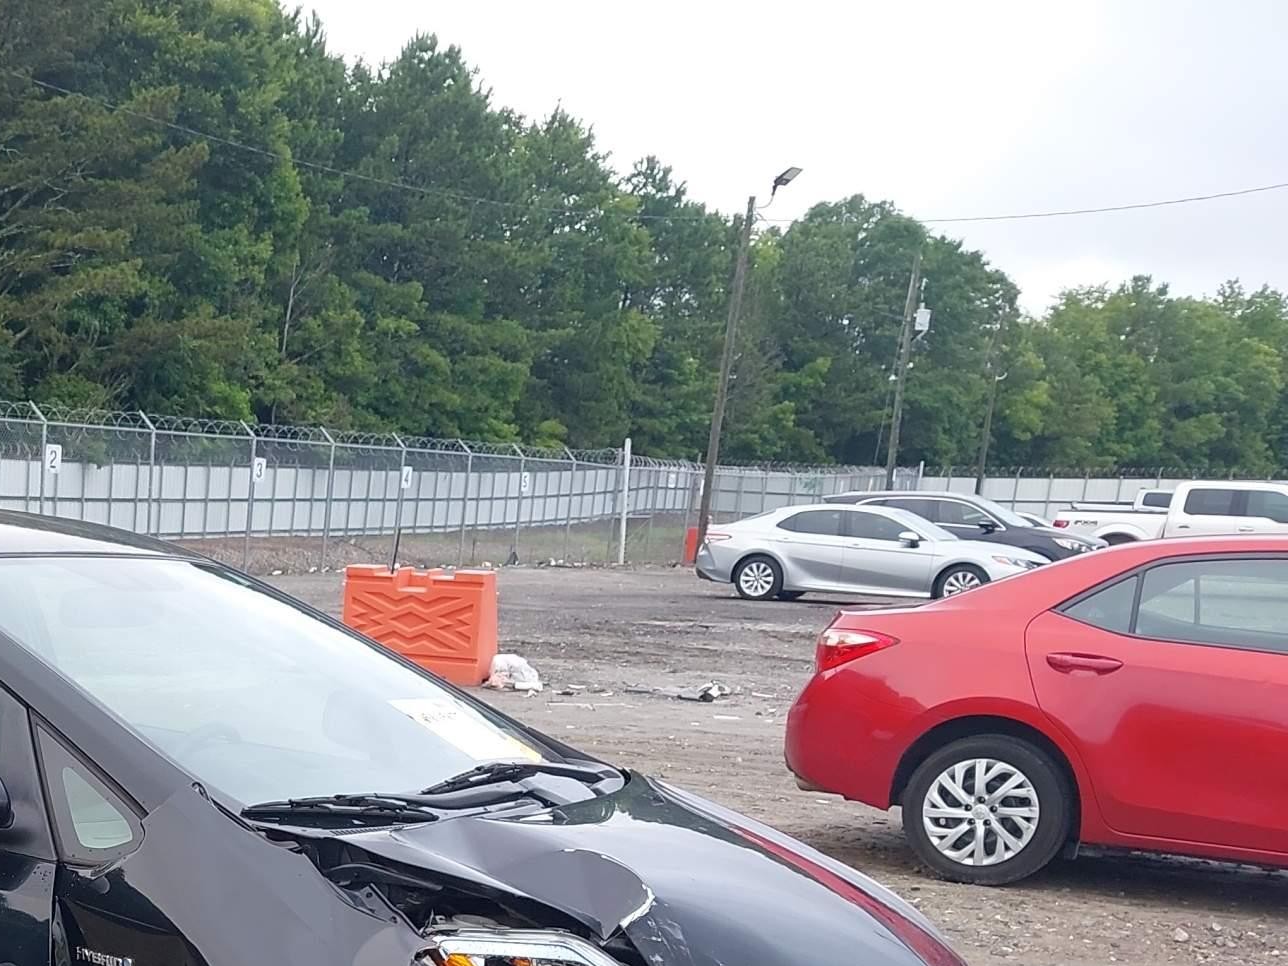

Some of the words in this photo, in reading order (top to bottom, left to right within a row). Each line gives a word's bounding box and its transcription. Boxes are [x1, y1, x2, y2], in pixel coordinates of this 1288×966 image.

[49, 450, 58, 469] 2
[256, 462, 263, 479] 3
[403, 470, 410, 486] 4
